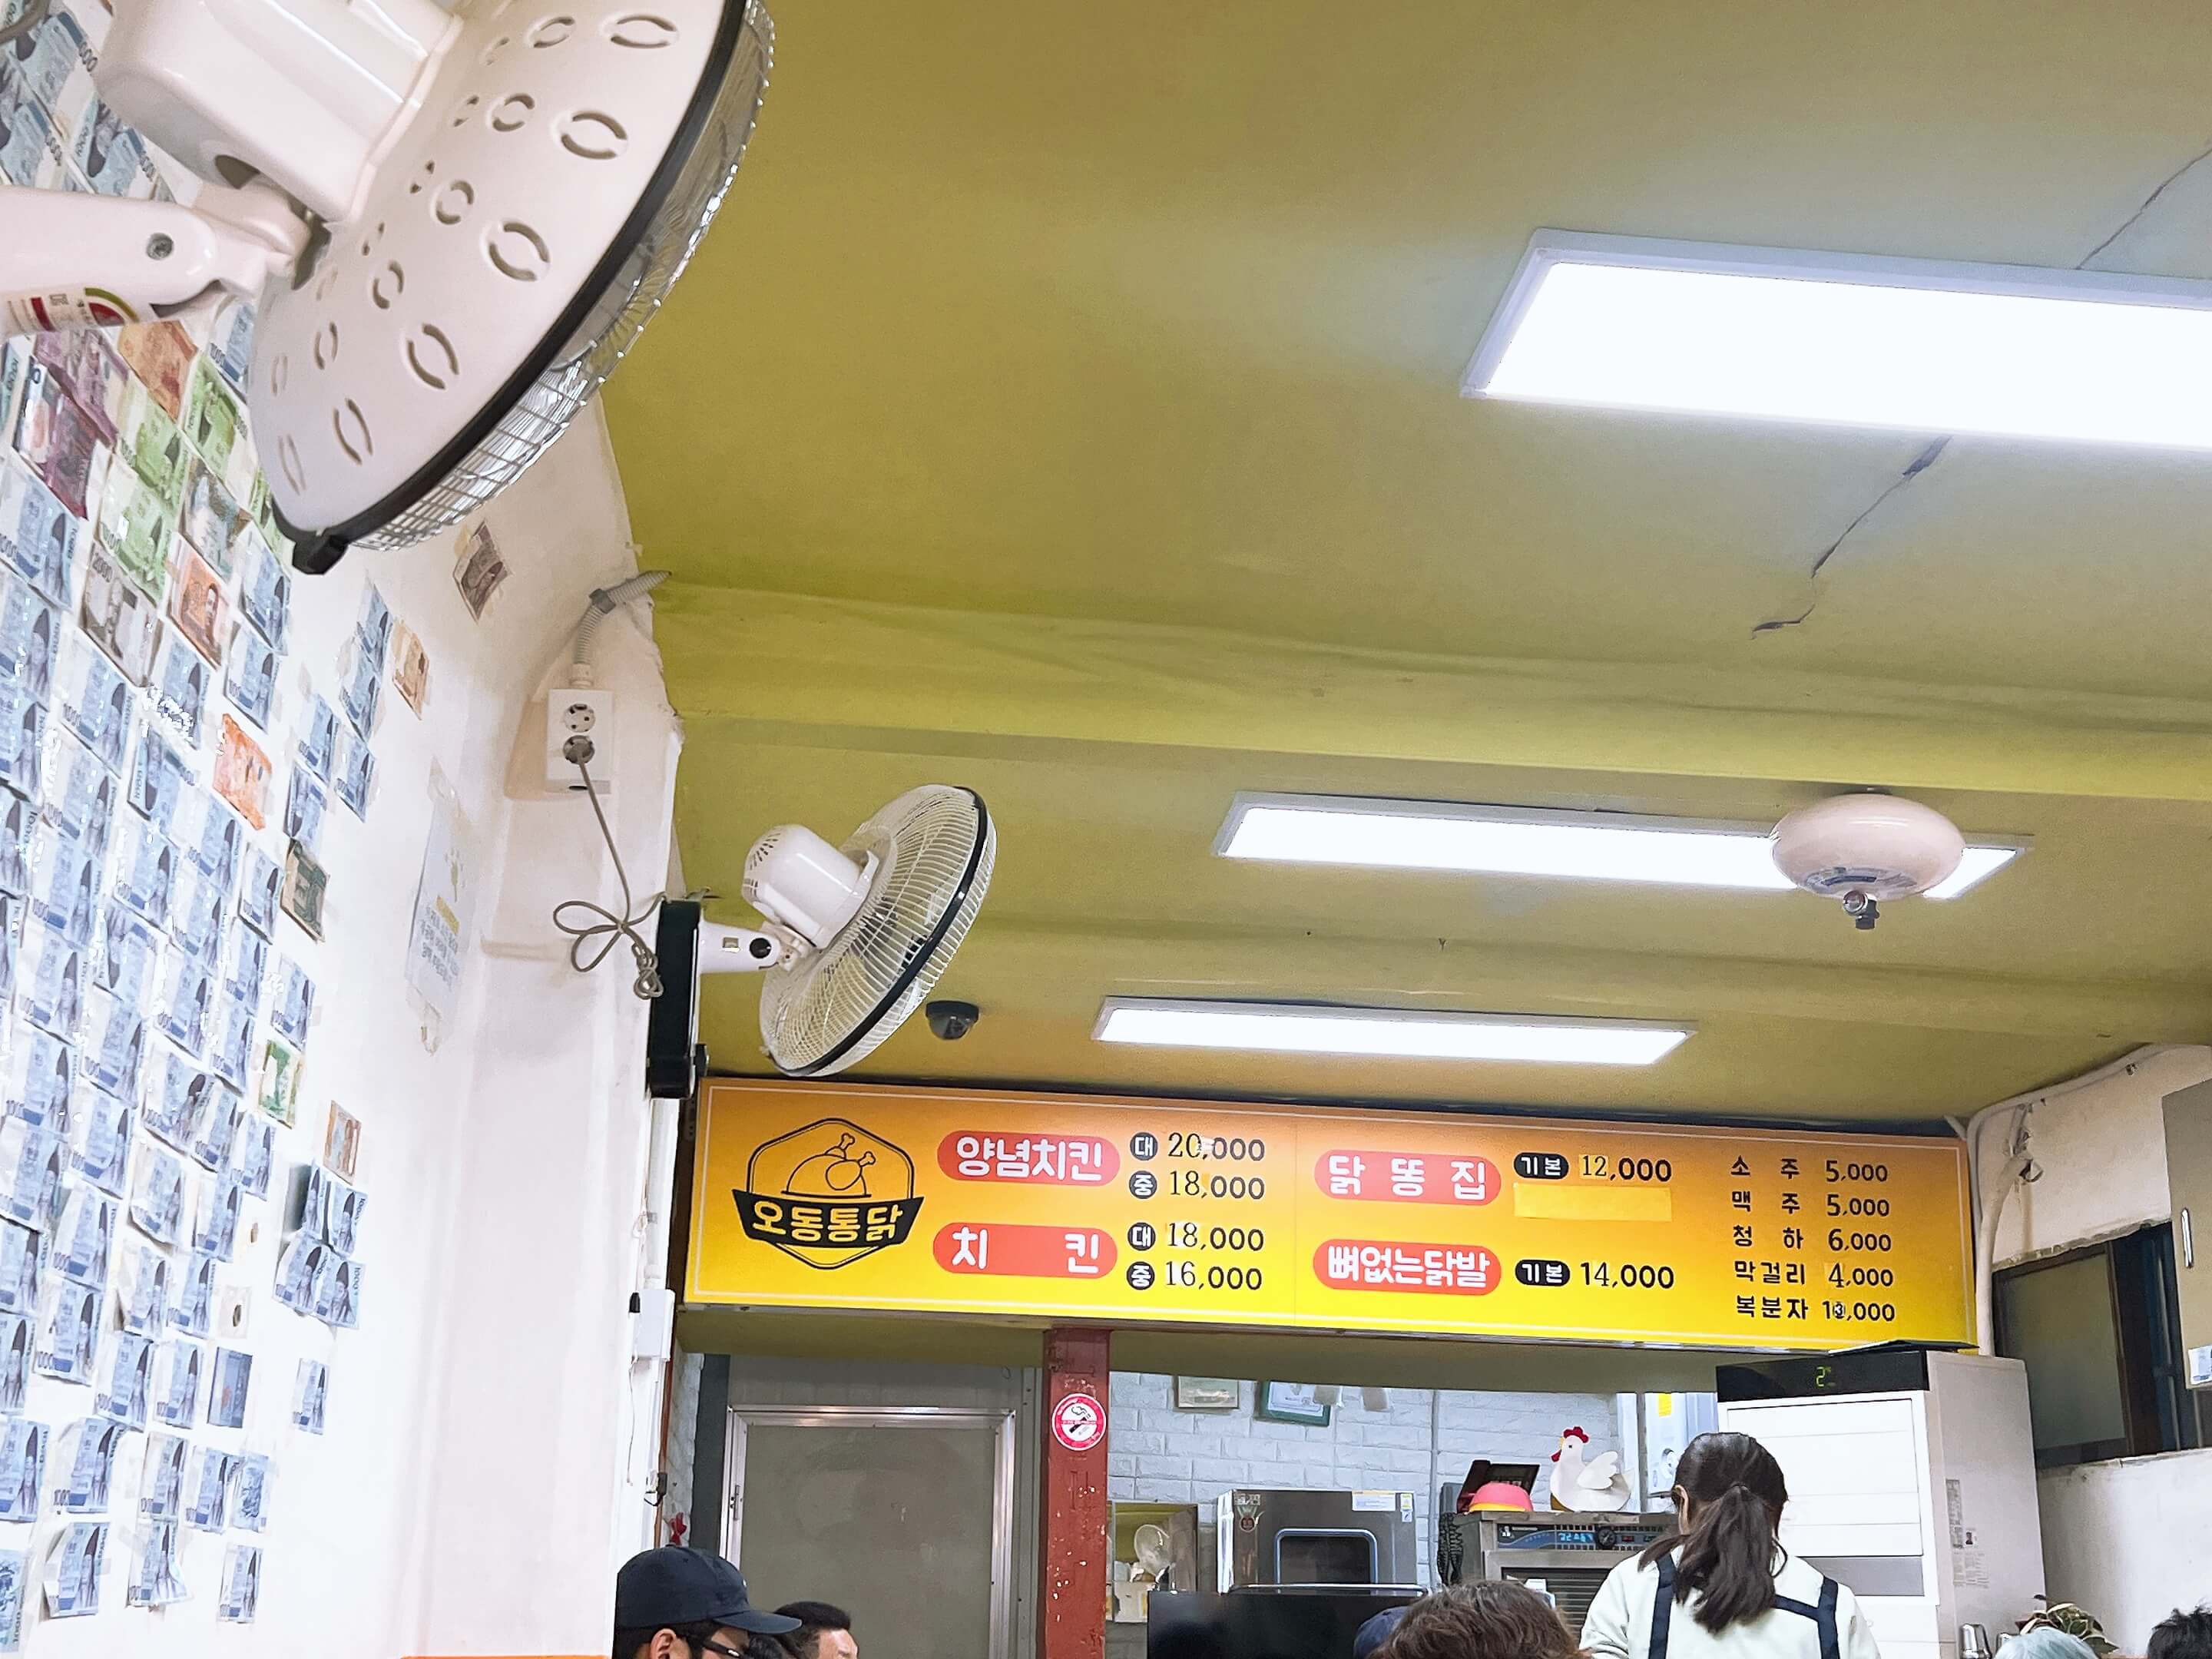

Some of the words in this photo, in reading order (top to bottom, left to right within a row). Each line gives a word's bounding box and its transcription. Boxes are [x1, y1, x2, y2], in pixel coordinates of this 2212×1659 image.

[956, 1135, 1102, 1181] 양념치킨
[1134, 1136, 1155, 1157] 대
[1167, 1132, 1266, 1162] 20,000
[1521, 1157, 1562, 1177] 기본
[1581, 1154, 1673, 1183] 12,000
[1134, 1174, 1154, 1197] 중
[1169, 1171, 1266, 1200] 18,000
[1825, 1160, 1889, 1183] 5,000
[1826, 1194, 1890, 1217] 5,000
[752, 1200, 904, 1243] 오동통닭
[1131, 1226, 1153, 1248] 대
[1167, 1222, 1266, 1253] 18,000
[1828, 1228, 1892, 1253] 6,000
[1131, 1266, 1151, 1287] 중
[1164, 1260, 1263, 1291] 16,000
[1327, 1244, 1491, 1289] 뼈없는닭발
[1521, 1263, 1564, 1284] 기본
[1580, 1261, 1674, 1290] 14,000
[1734, 1260, 1806, 1286] 막걸리
[1828, 1262, 1895, 1289] 4,000
[1736, 1294, 1810, 1320] 복분자
